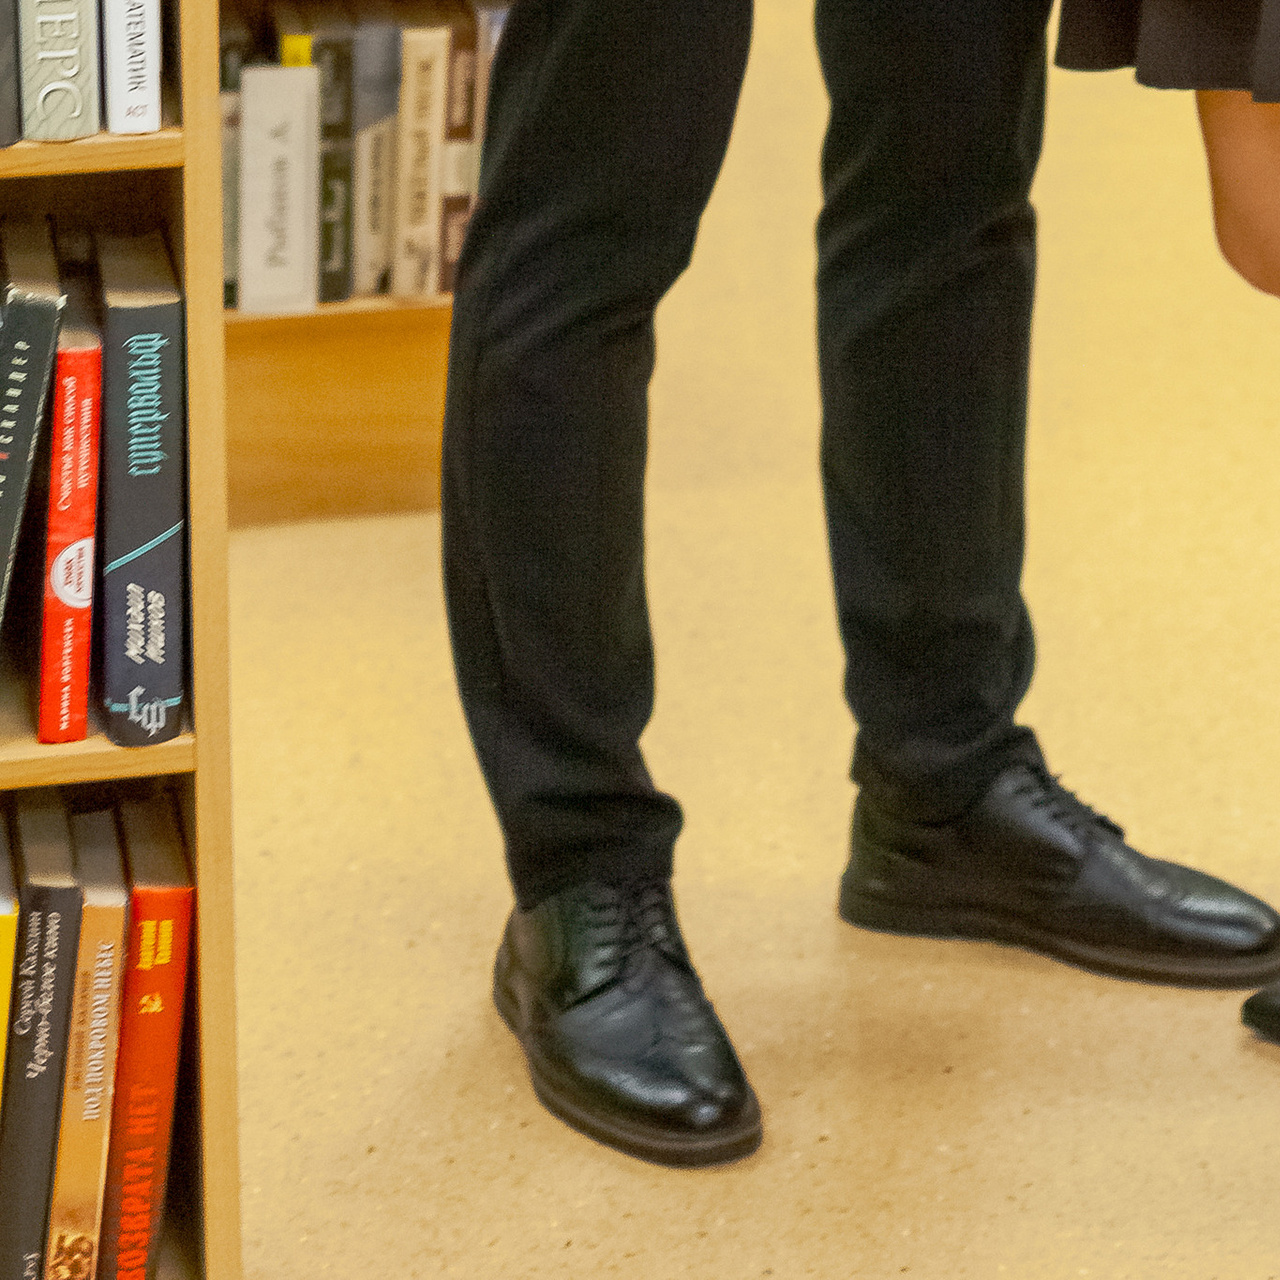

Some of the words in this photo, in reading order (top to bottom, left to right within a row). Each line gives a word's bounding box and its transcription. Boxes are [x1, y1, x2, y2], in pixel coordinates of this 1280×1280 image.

[93, 942, 115, 990] НЕБЕС
[85, 993, 111, 1085] ПОКРОВОМ
[82, 1087, 104, 1121] ПОД
